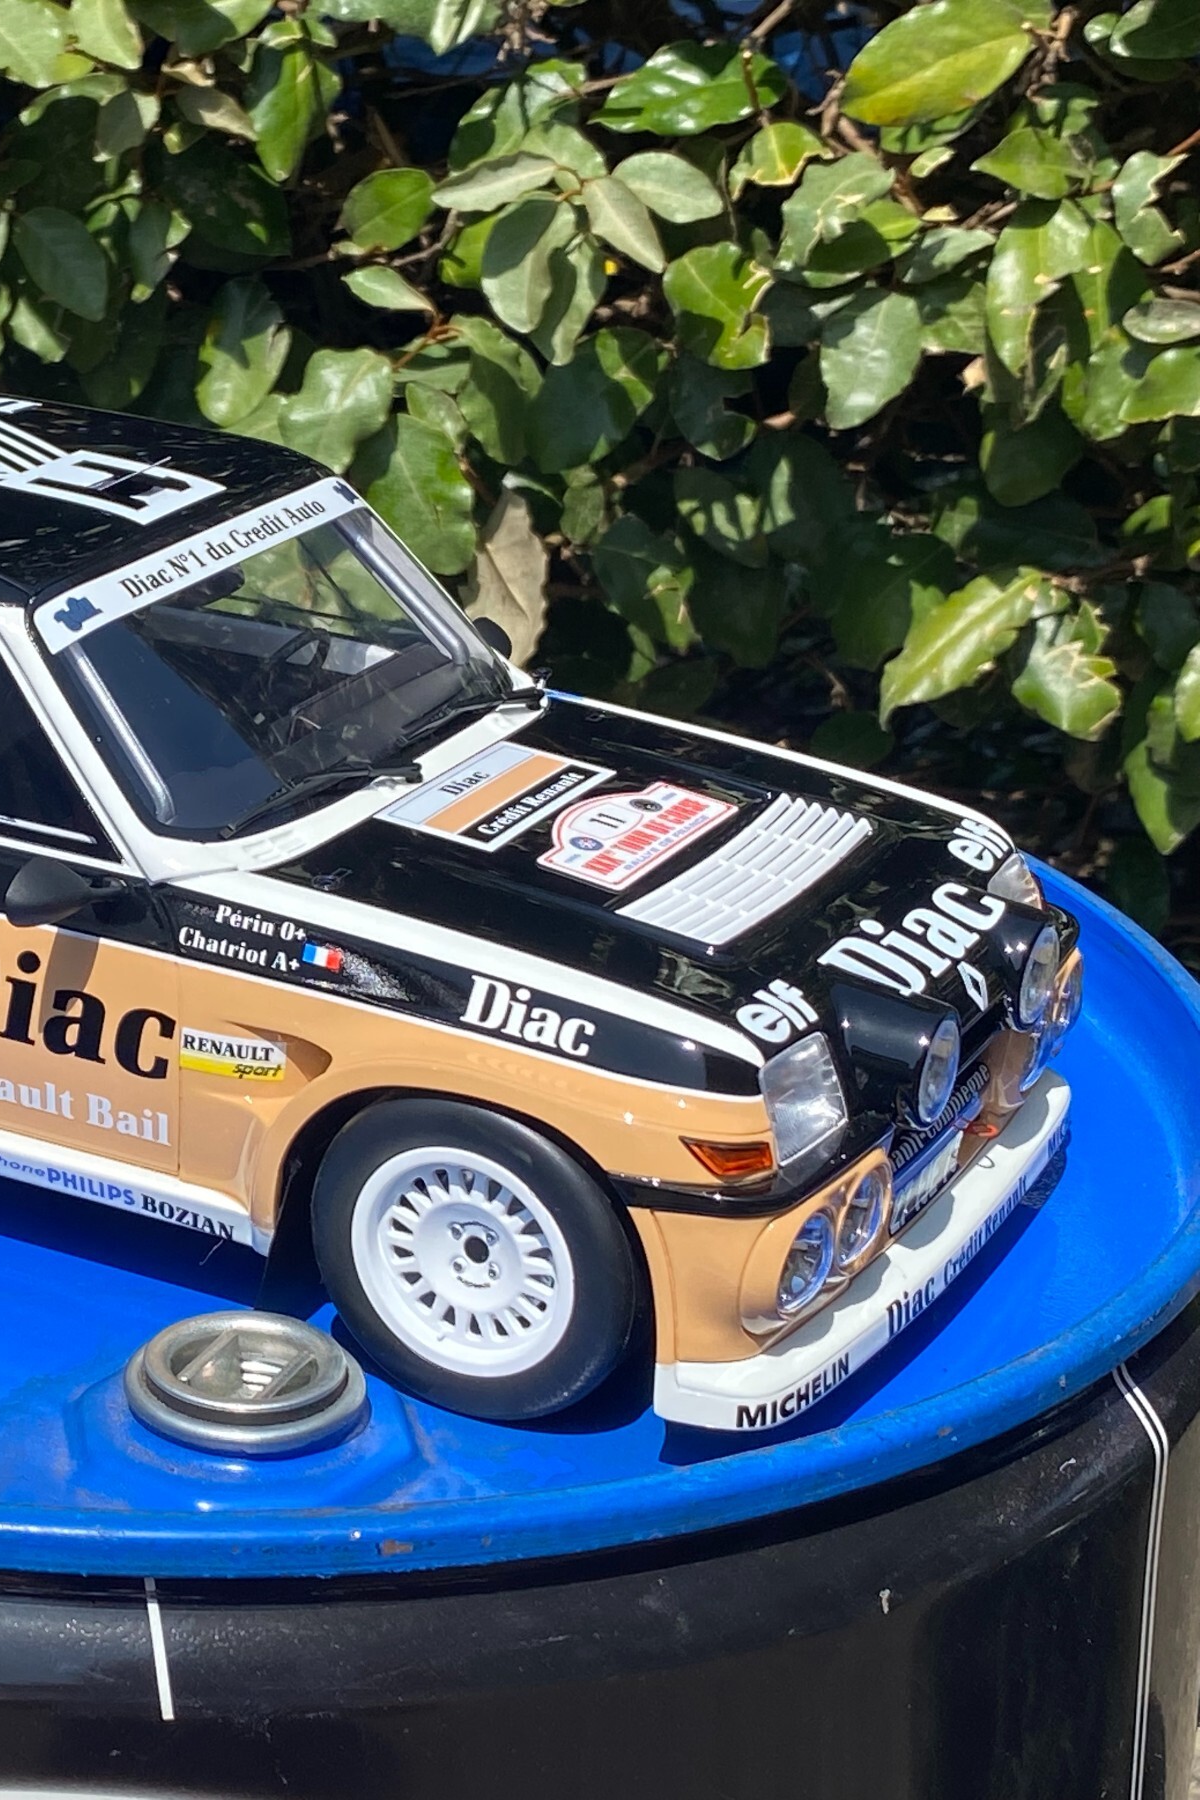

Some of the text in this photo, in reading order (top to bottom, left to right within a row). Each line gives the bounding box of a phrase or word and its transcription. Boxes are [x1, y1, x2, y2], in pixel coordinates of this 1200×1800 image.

[119, 569, 174, 598] Diac
[206, 541, 235, 561] du
[282, 500, 326, 526] Auto
[439, 770, 490, 796] Diac
[524, 772, 586, 810] Renault
[589, 812, 627, 829] 11
[947, 818, 1010, 871] elf
[179, 926, 300, 972] Chatriot A+
[215, 904, 275, 937] Périn
[816, 881, 1005, 996] Diac
[460, 974, 596, 1057] Diac
[736, 979, 819, 1043] elf
[182, 1033, 275, 1061] RENAULT
[232, 1062, 283, 1079] sport
[86, 1086, 172, 1147] Bail
[47, 1167, 135, 1206] PHILIPS
[141, 1193, 235, 1240] BOZIAN
[886, 1276, 935, 1341] Diac
[736, 1352, 850, 1428] MICHELIN
